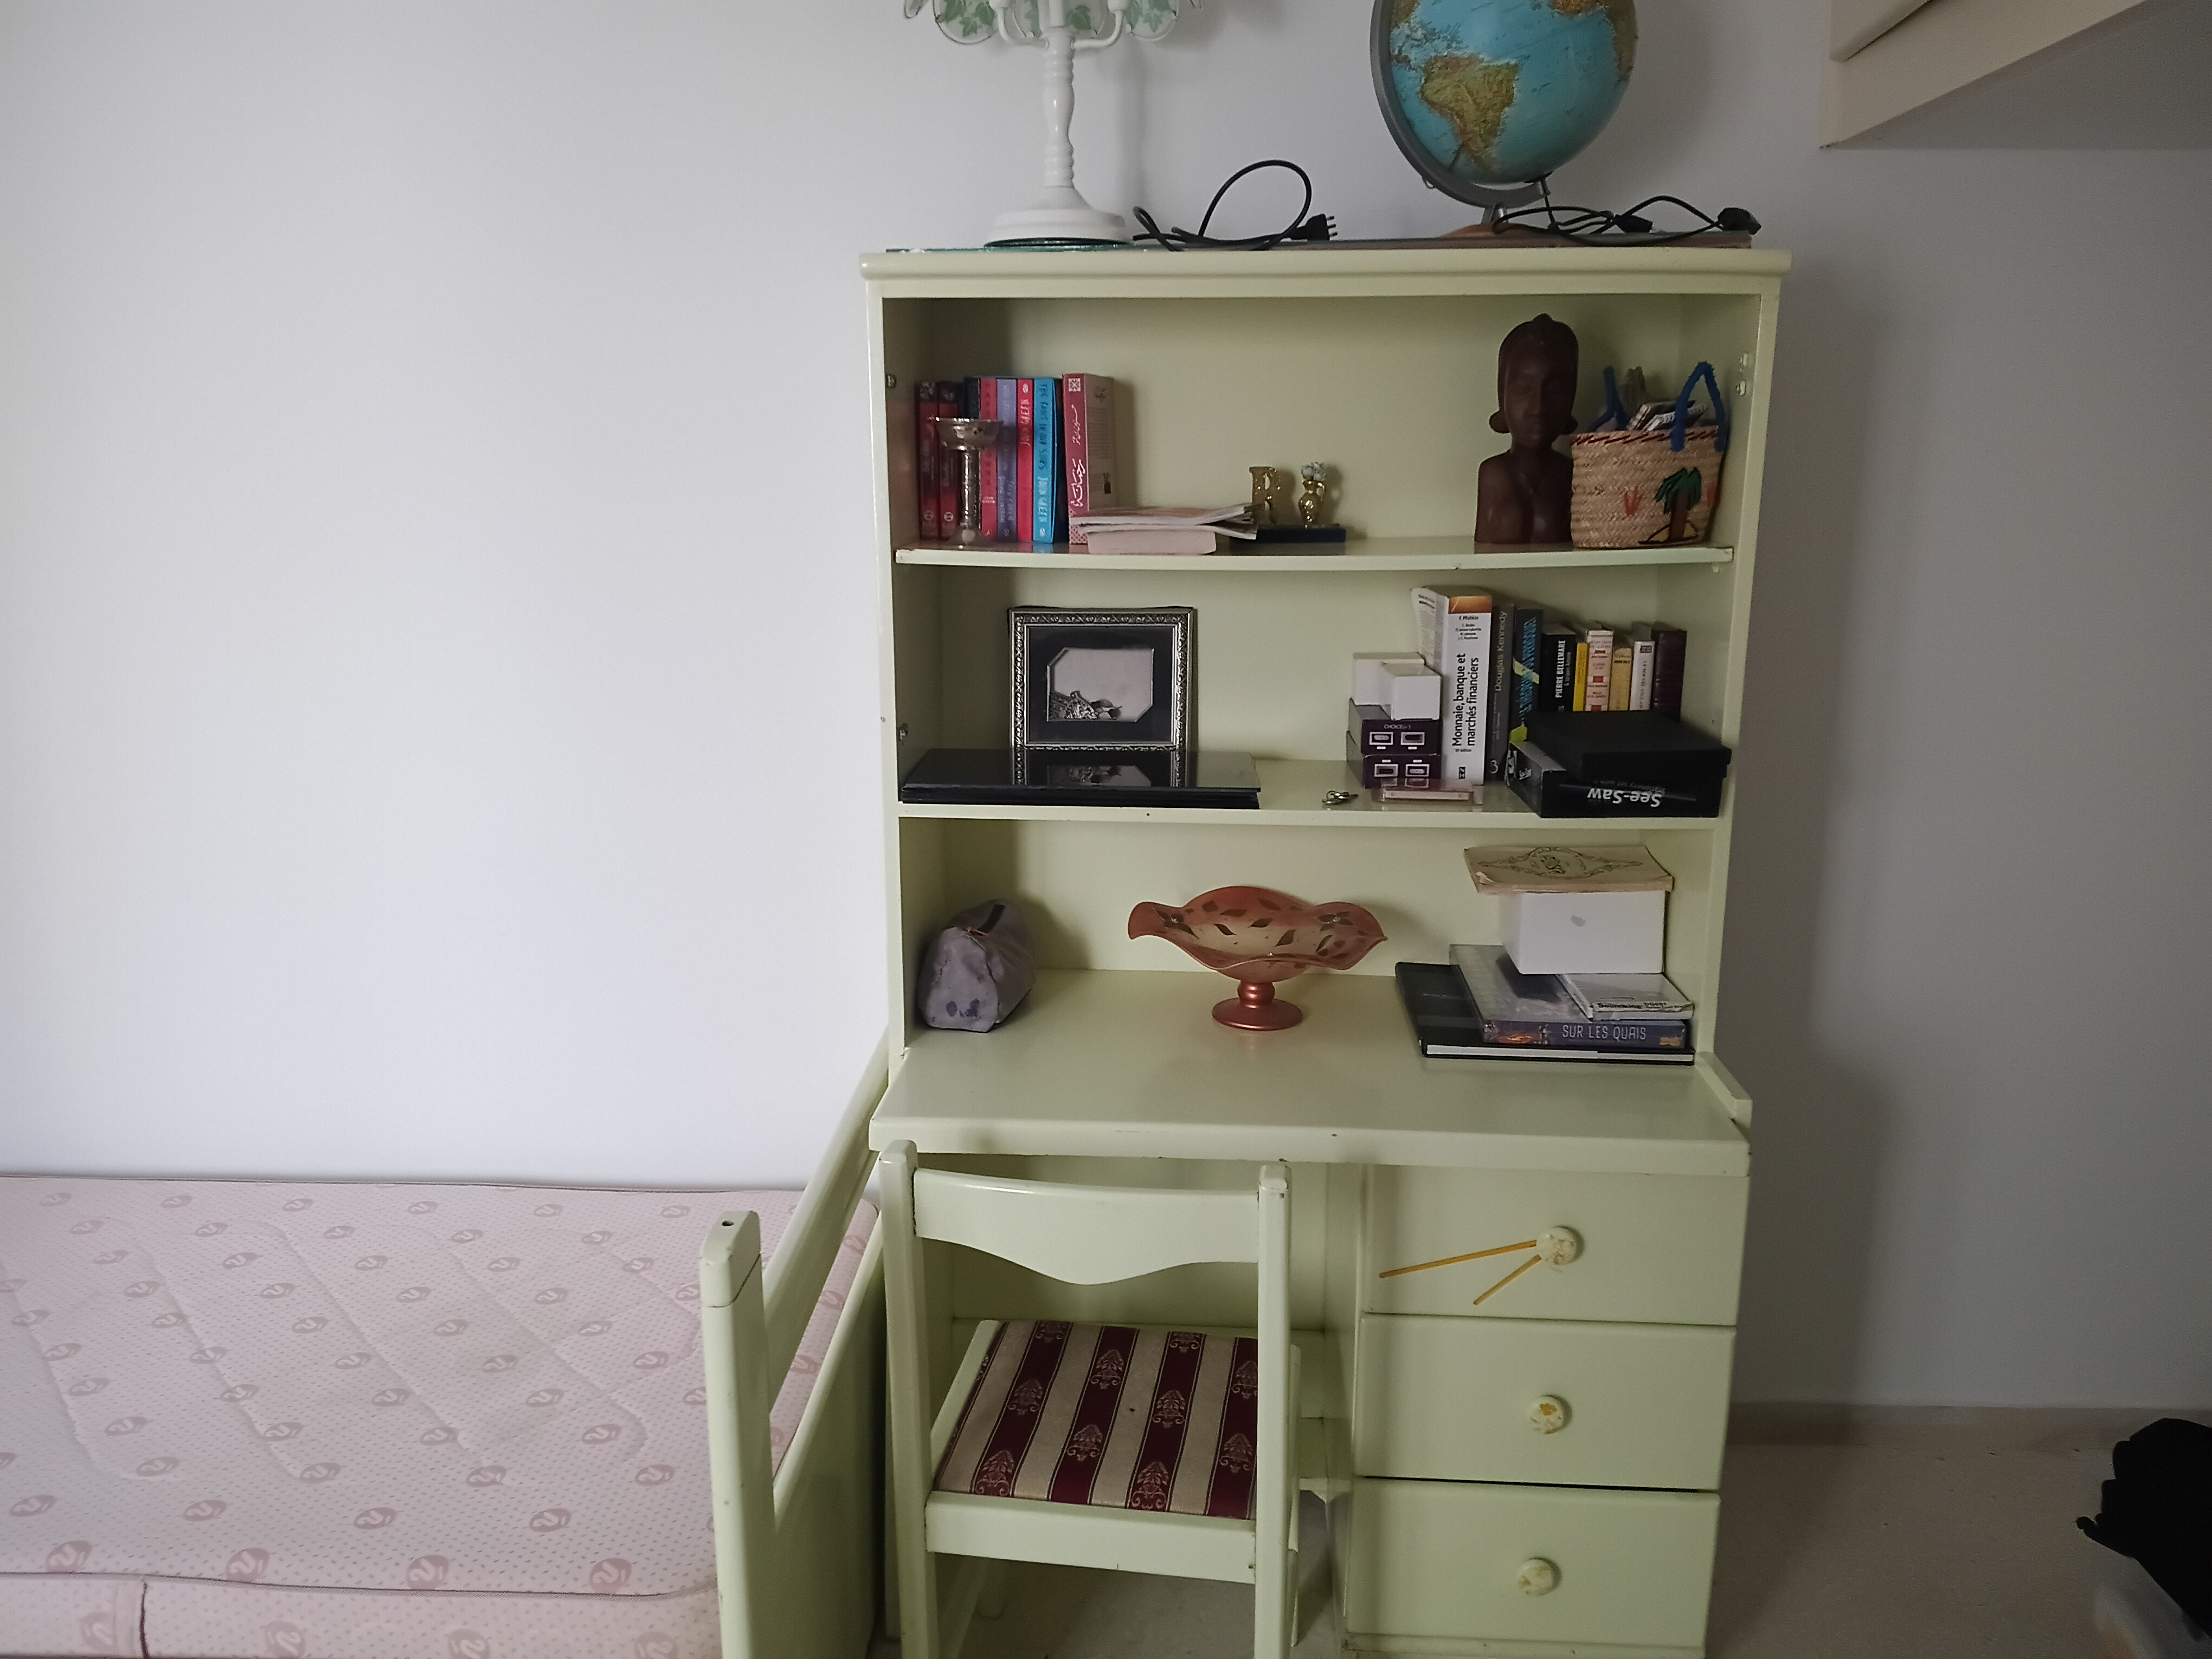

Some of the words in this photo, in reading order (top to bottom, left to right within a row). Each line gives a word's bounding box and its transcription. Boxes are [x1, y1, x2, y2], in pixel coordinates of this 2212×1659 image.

[1496, 610, 1508, 652] Kennedy
[1456, 653, 1466, 664] et
[1494, 654, 1504, 692] Douglas
[1557, 639, 1566, 675] BELLEMARE
[1453, 666, 1468, 701] banque
[1466, 657, 1479, 704] financiers
[1554, 676, 1564, 698] PIERRE
[1451, 703, 1465, 747] Monnaie,
[1465, 706, 1477, 747] marchés
[1586, 788, 1662, 808] See-Saw
[1561, 1024, 1584, 1038] SUR
[1588, 1025, 1609, 1039] LES
[1612, 1026, 1647, 1043] QUAIS
